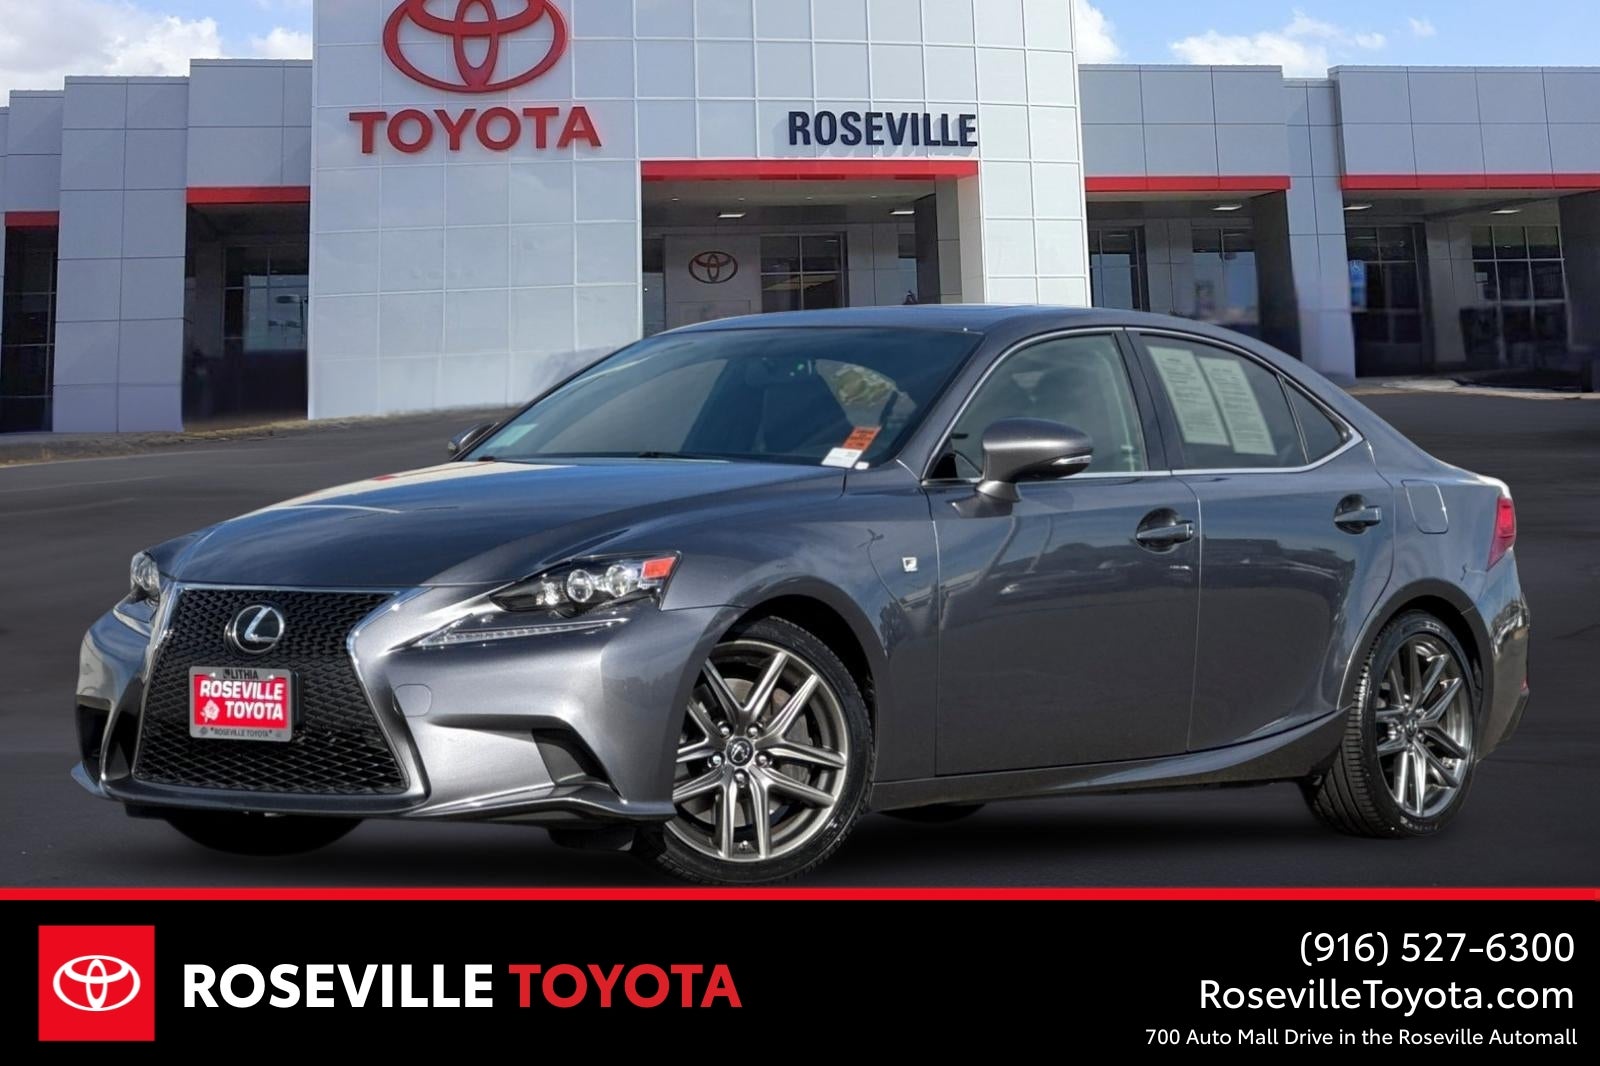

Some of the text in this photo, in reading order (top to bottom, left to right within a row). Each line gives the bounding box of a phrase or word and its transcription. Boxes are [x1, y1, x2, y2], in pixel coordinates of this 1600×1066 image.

[349, 106, 602, 154] TOYOTA
[788, 110, 979, 147] ROSEVILLE
[231, 669, 259, 680] LITHIA
[200, 680, 284, 700] ROSEVILLE
[225, 701, 284, 721] TOYOTA
